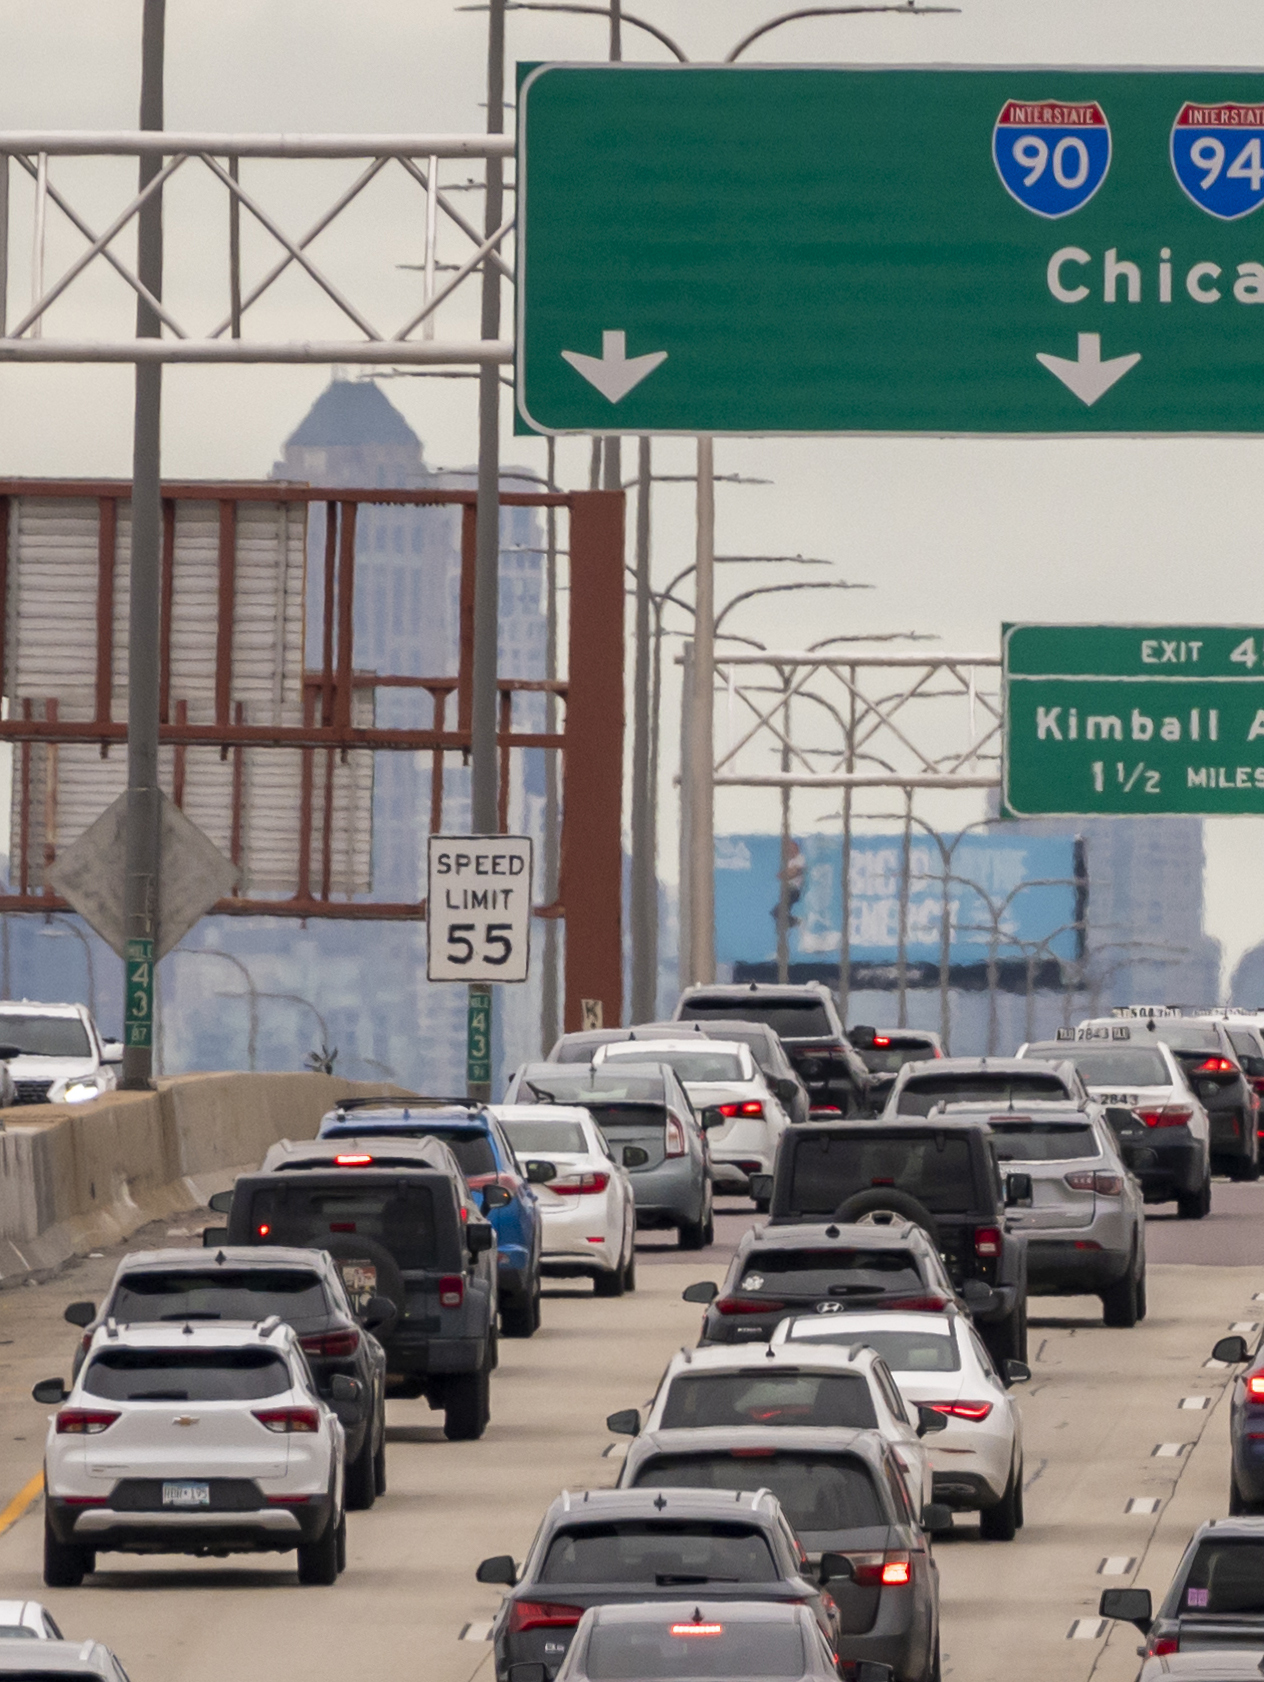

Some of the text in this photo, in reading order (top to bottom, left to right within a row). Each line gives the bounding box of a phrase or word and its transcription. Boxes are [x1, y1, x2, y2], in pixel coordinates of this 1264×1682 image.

[1009, 106, 1094, 125] INTERSTATE
[1012, 135, 1089, 189] 90
[1189, 137, 1264, 191] 94
[1140, 640, 1203, 663] EXIT
[1035, 706, 1218, 741] Kimball
[436, 853, 525, 876] SPEED
[445, 888, 514, 911] LIMIT
[446, 923, 513, 966] 55
[1100, 1093, 1139, 1106] 2843
